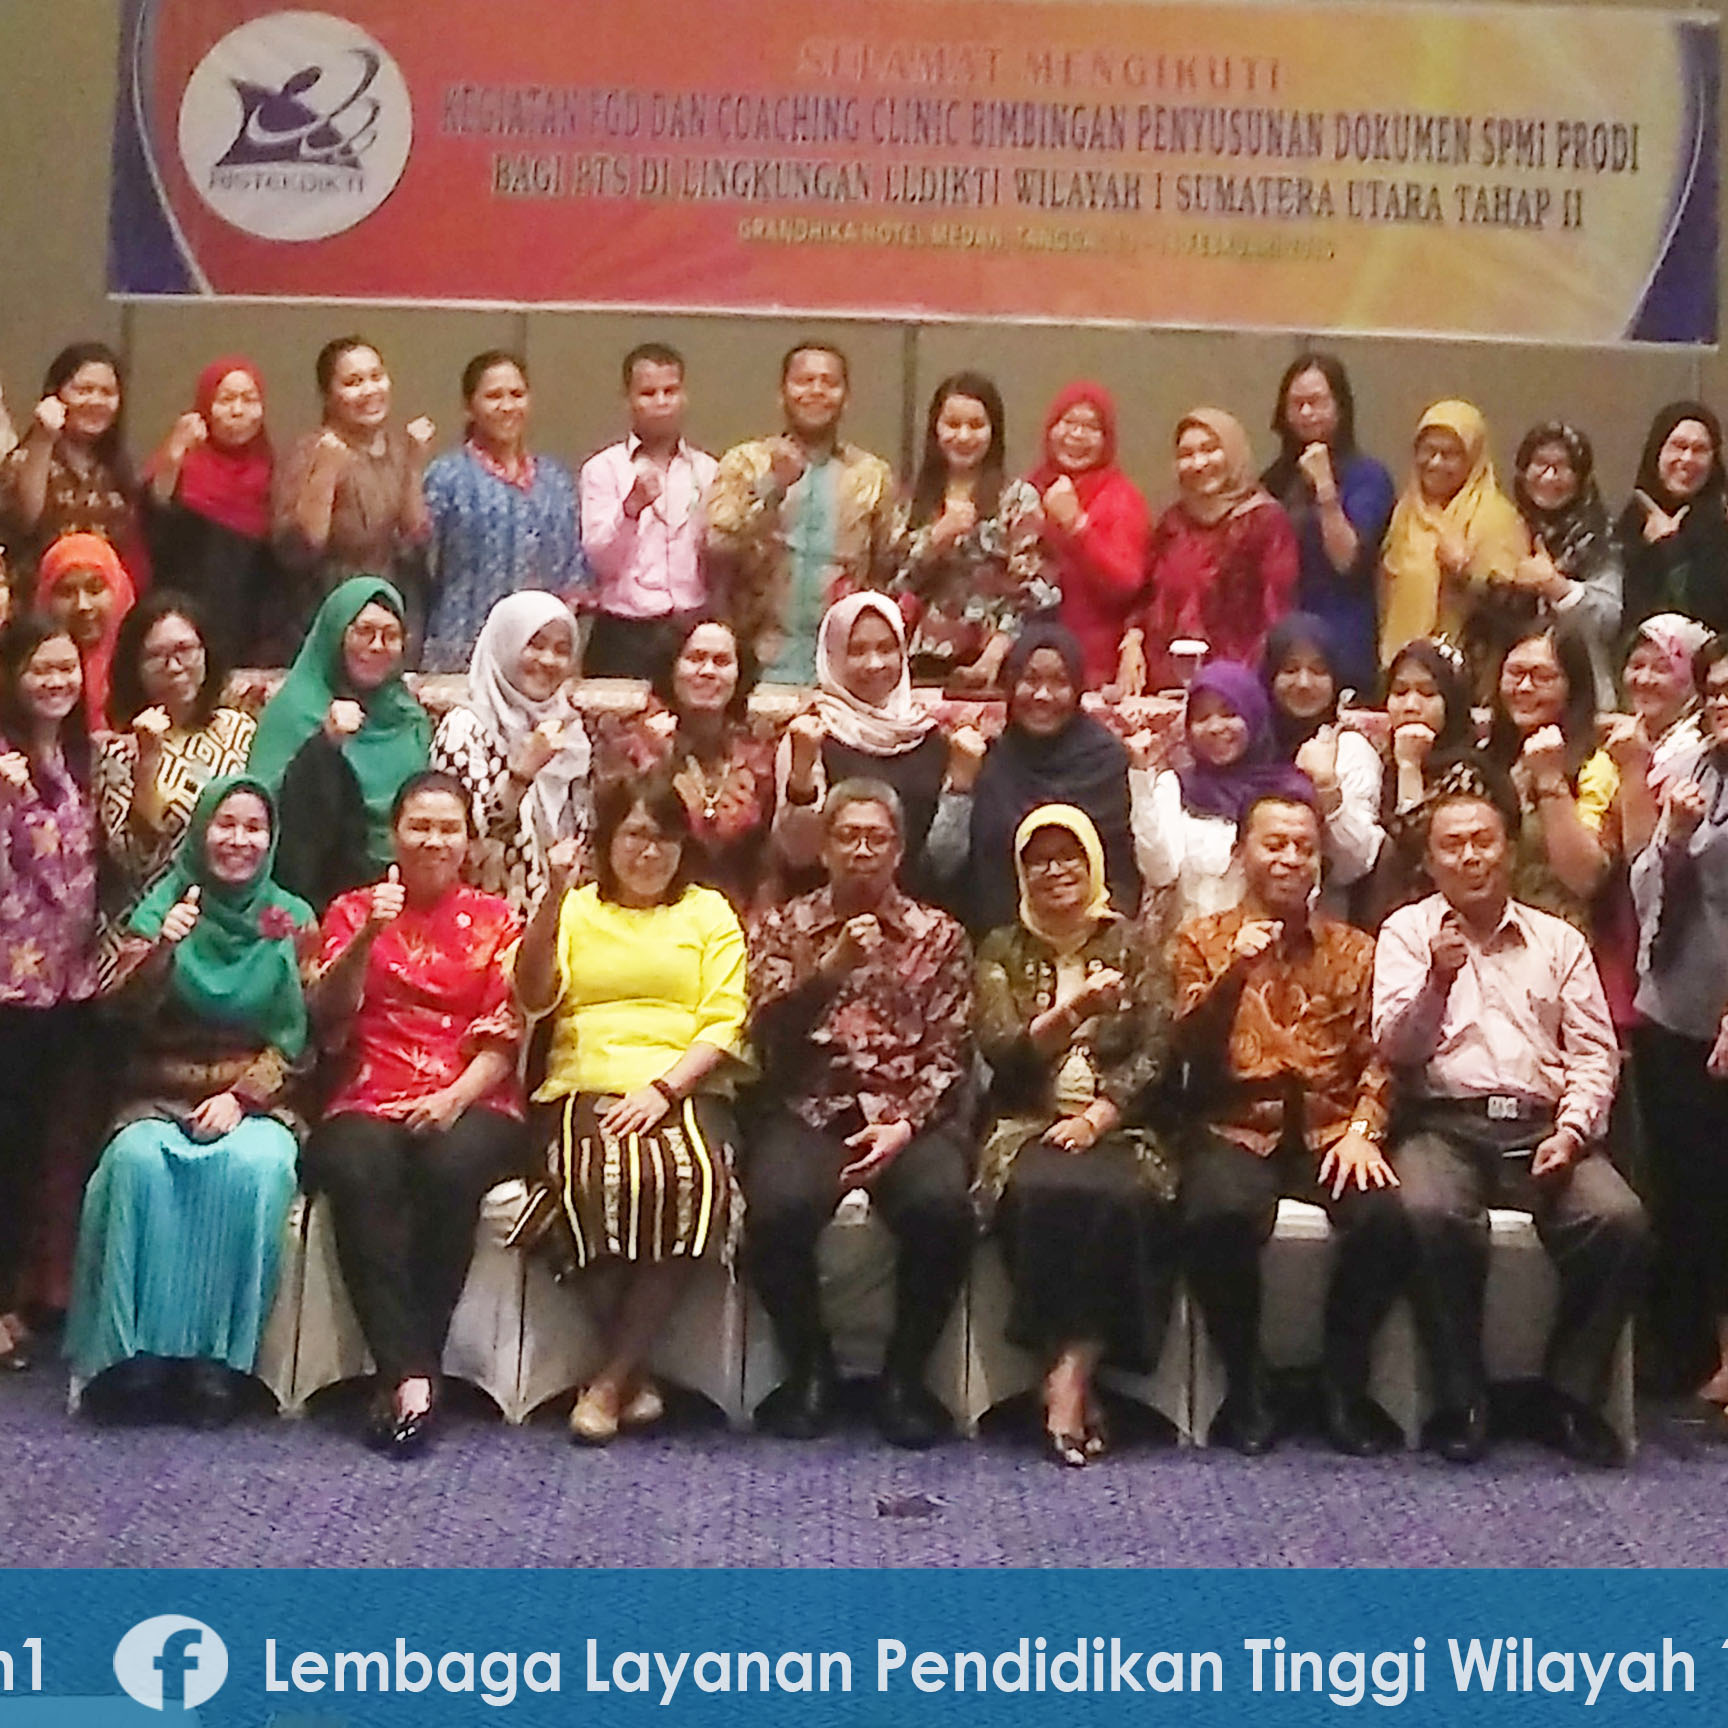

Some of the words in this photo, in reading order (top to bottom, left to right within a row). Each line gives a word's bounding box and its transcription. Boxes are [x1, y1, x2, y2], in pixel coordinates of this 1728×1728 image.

[1024, 49, 1281, 91] MENGIKUTI
[650, 91, 707, 139] DAN
[717, 93, 860, 145] COACHING
[872, 96, 961, 147] CLINIC
[972, 100, 1125, 152] BIMBINGAN
[1137, 104, 1324, 158] PENYUSUNAN
[1334, 110, 1472, 165] DOKUMEN
[1556, 120, 1639, 173] PRODI
[493, 153, 562, 194] BAGI
[574, 155, 630, 196] PTS
[640, 157, 670, 197] DI
[681, 158, 870, 202] LINGKUNGAN
[883, 164, 1000, 206] LLDIKTI
[1013, 168, 1141, 210] WILAYAH
[1153, 172, 1163, 210] I
[1176, 173, 1335, 217] SUMATERA
[1347, 179, 1444, 221] UTARA
[1454, 183, 1551, 228] TAHAP
[1562, 188, 1584, 228] II
